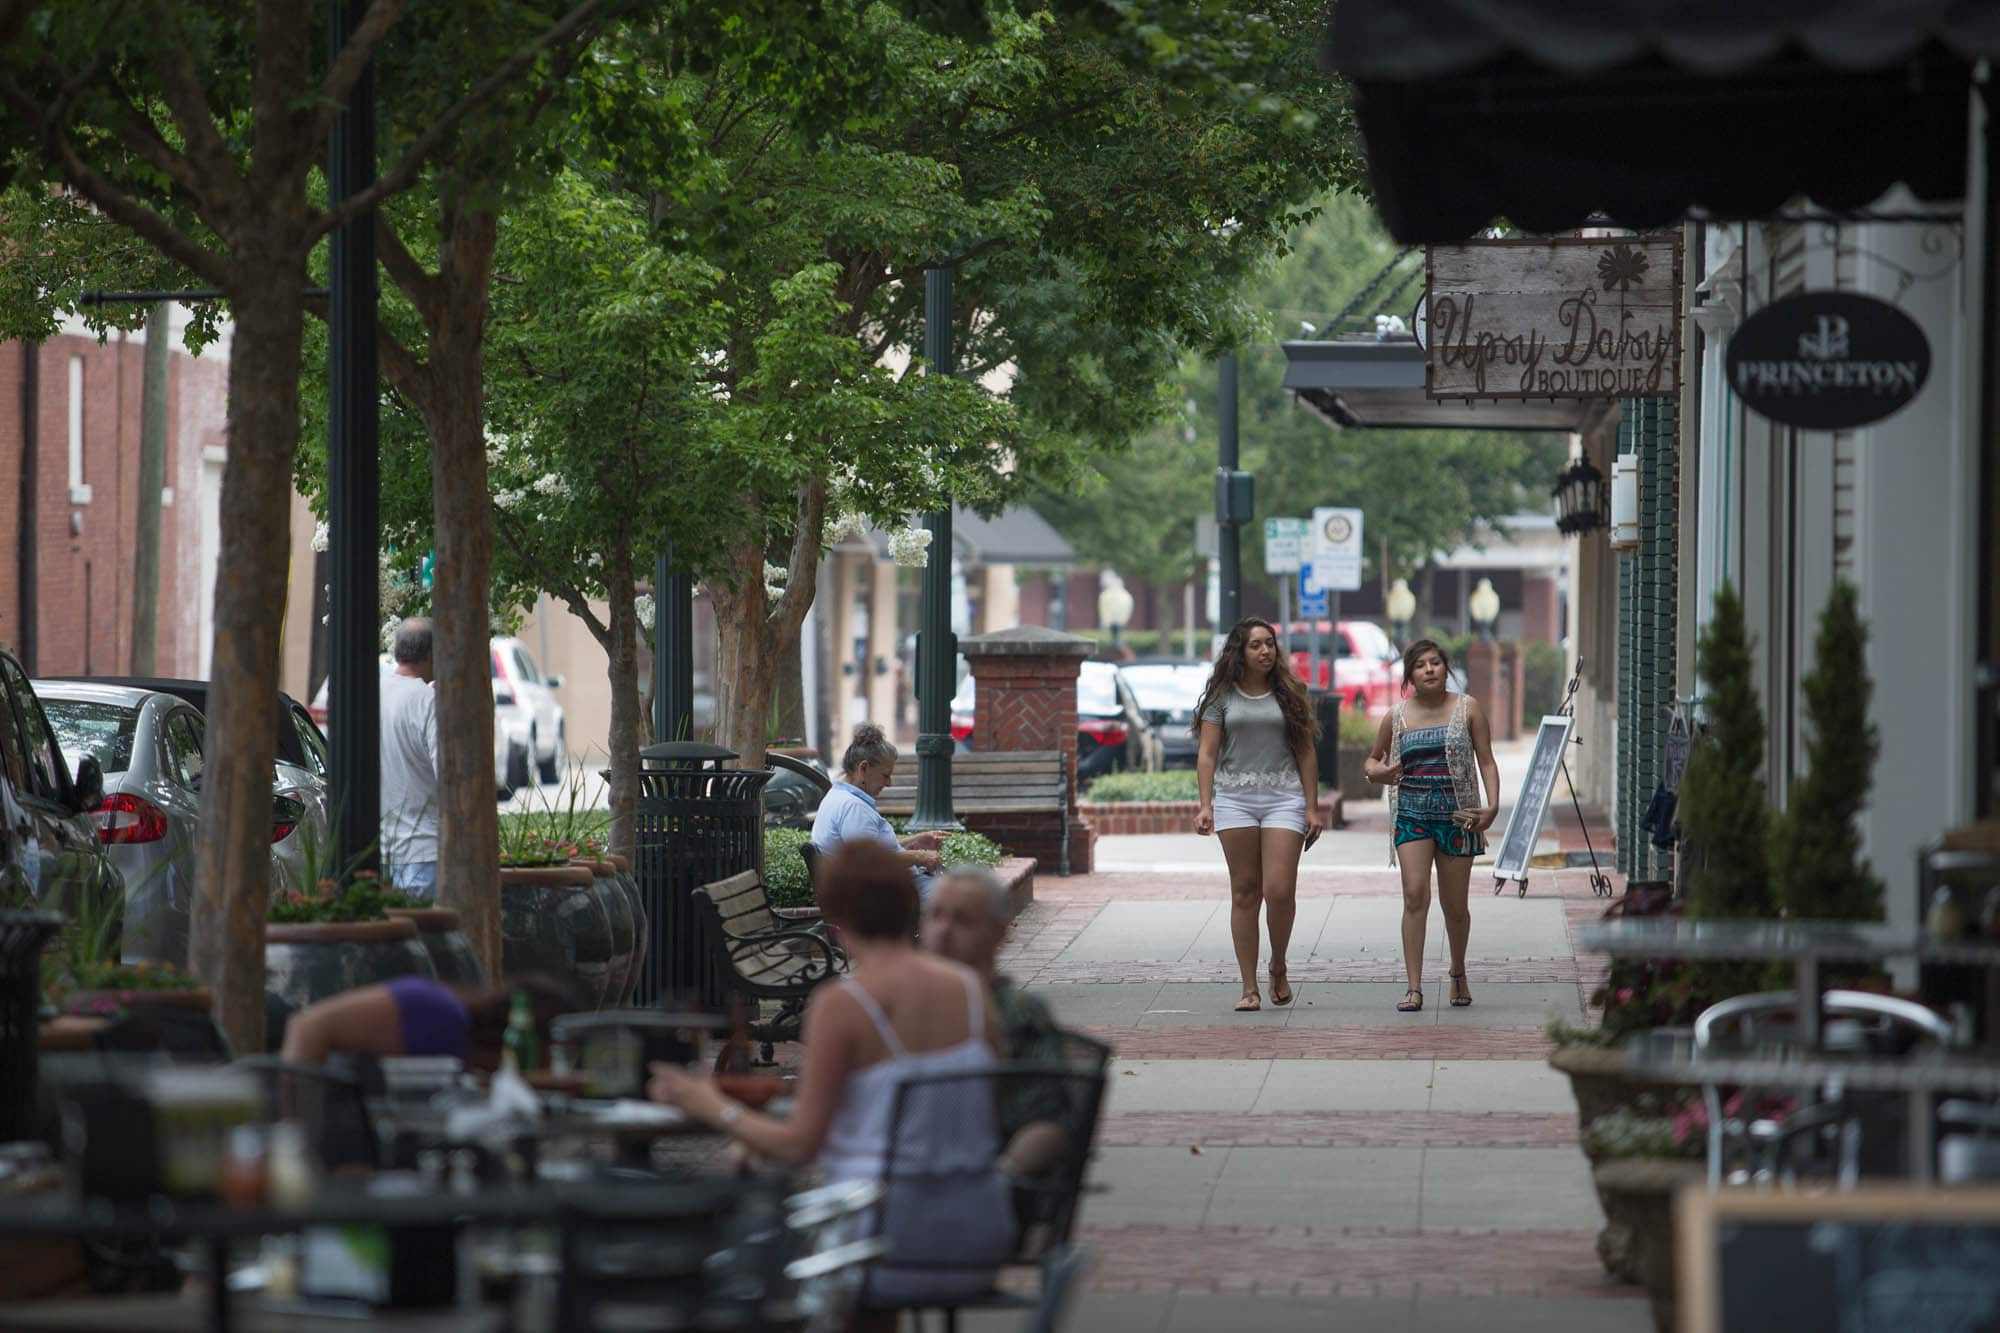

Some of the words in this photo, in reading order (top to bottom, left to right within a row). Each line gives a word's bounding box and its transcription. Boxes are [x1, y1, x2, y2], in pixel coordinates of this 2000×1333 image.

[1433, 293, 1545, 393] Upsy
[1552, 286, 1674, 391] Daisy
[1538, 368, 1645, 392] BOUTIQUE
[1737, 360, 1918, 386] PRINCETON
